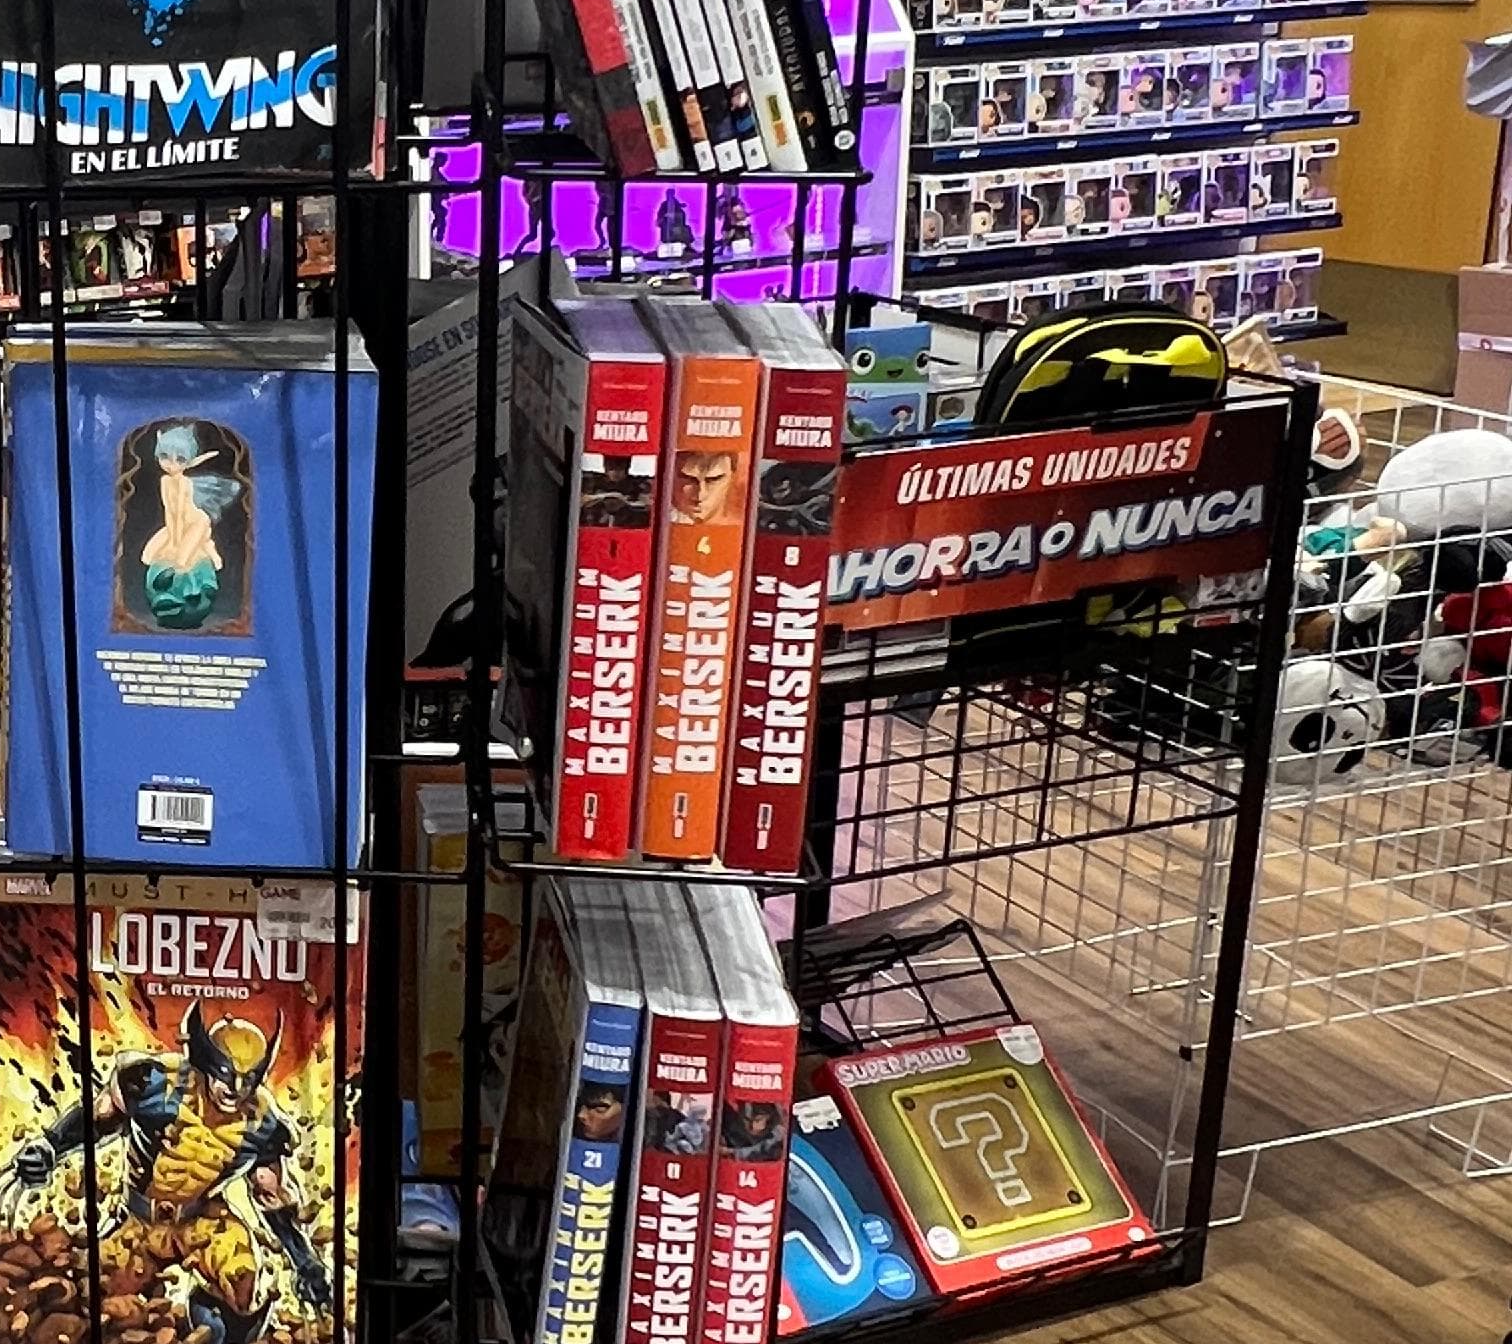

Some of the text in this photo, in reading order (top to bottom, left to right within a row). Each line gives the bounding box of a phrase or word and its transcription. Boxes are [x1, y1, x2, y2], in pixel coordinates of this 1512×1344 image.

[70, 132, 241, 175] EN EL LÍMITE
[593, 422, 648, 443] MIURA
[687, 417, 743, 438] MIURA
[776, 428, 832, 450] MIURA
[897, 436, 1191, 506] ÚLTIMAS UNIDADES
[1079, 485, 1265, 558] NUNCA
[564, 568, 599, 777] MAXIMUM
[586, 572, 642, 776] BERSERK
[652, 565, 690, 775] MAXIMUM
[674, 569, 733, 774] BERSERK
[735, 575, 777, 787] MAXIMUM
[759, 579, 822, 785] BERSERK
[146, 982, 168, 997] EL
[582, 1054, 630, 1073] MIURA
[656, 1064, 707, 1085] MIURA
[732, 1072, 782, 1092] MIURA
[837, 1043, 972, 1087] SUPER MARIO
